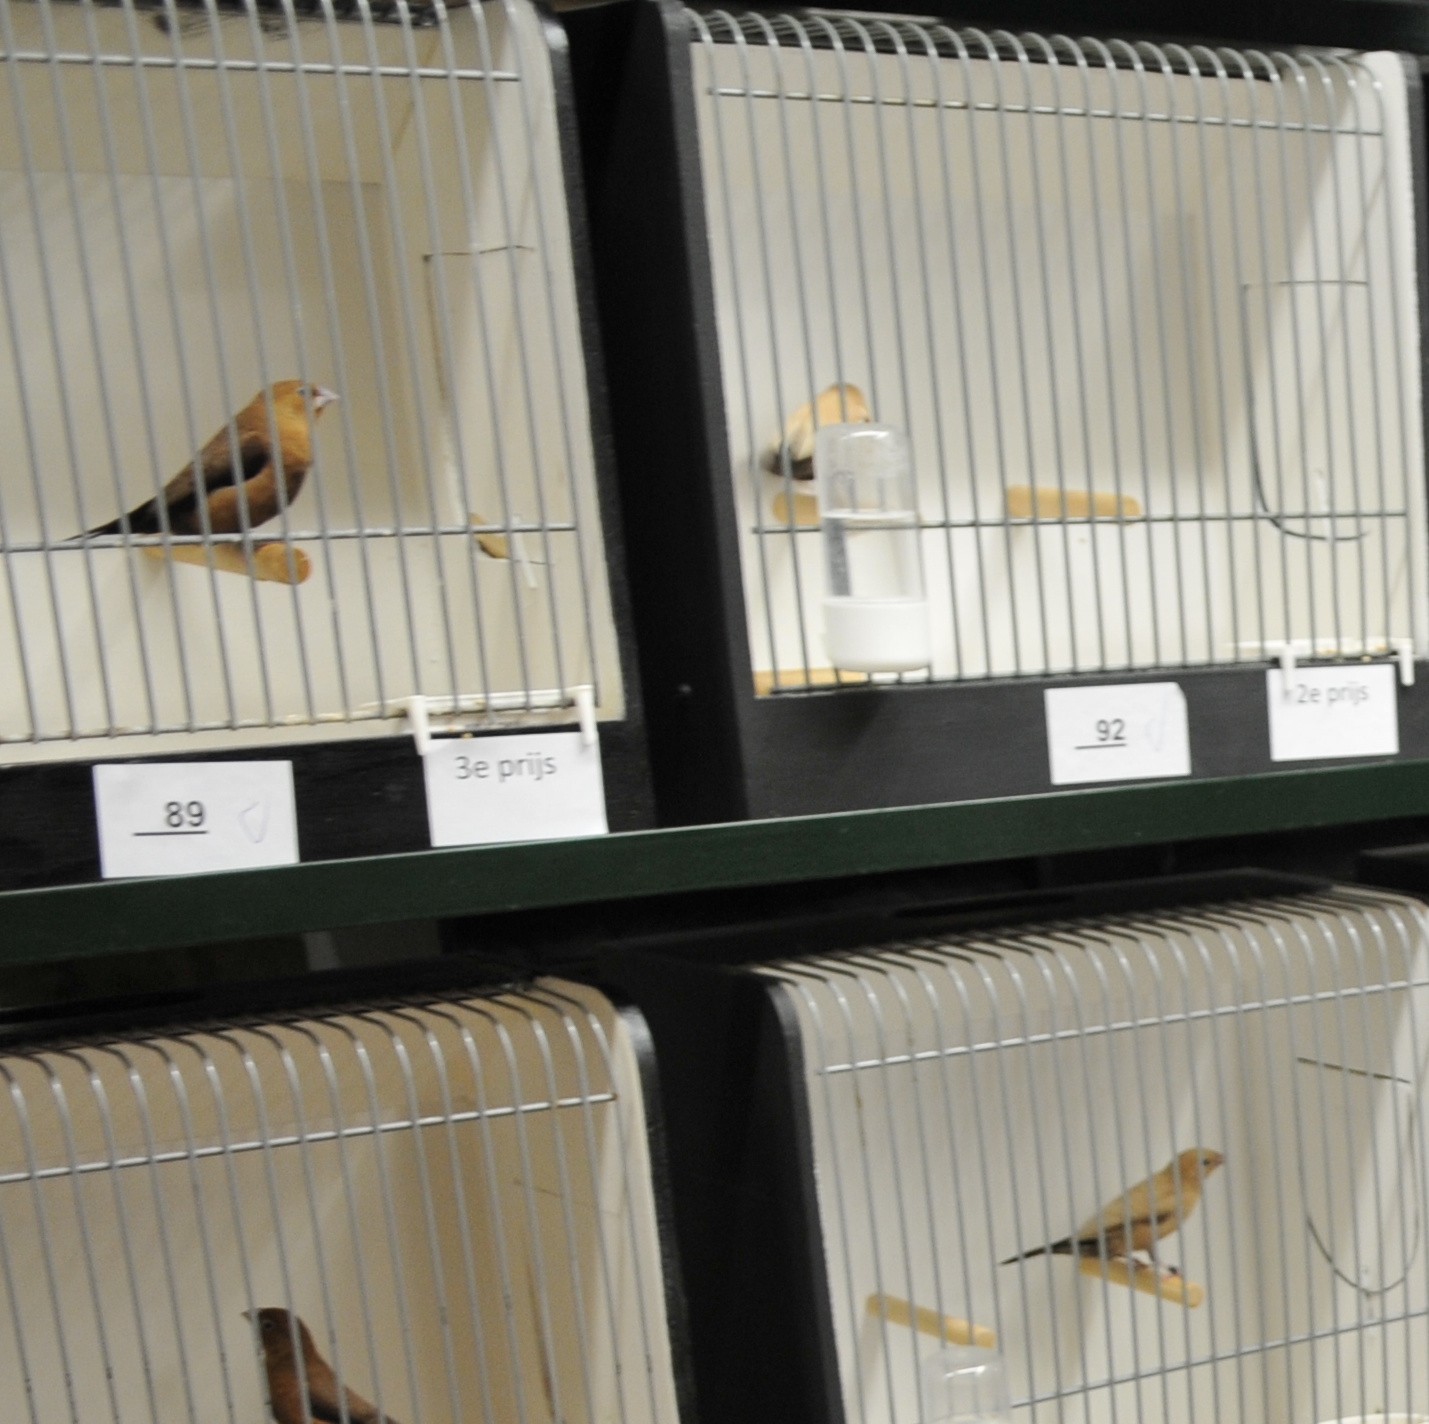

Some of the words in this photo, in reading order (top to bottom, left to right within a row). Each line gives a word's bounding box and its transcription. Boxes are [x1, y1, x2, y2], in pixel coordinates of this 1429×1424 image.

[1328, 680, 1369, 705] prijs
[1096, 718, 1126, 742] 92
[455, 755, 490, 780] 3e
[499, 750, 558, 782] prijs
[164, 800, 208, 828] 89
